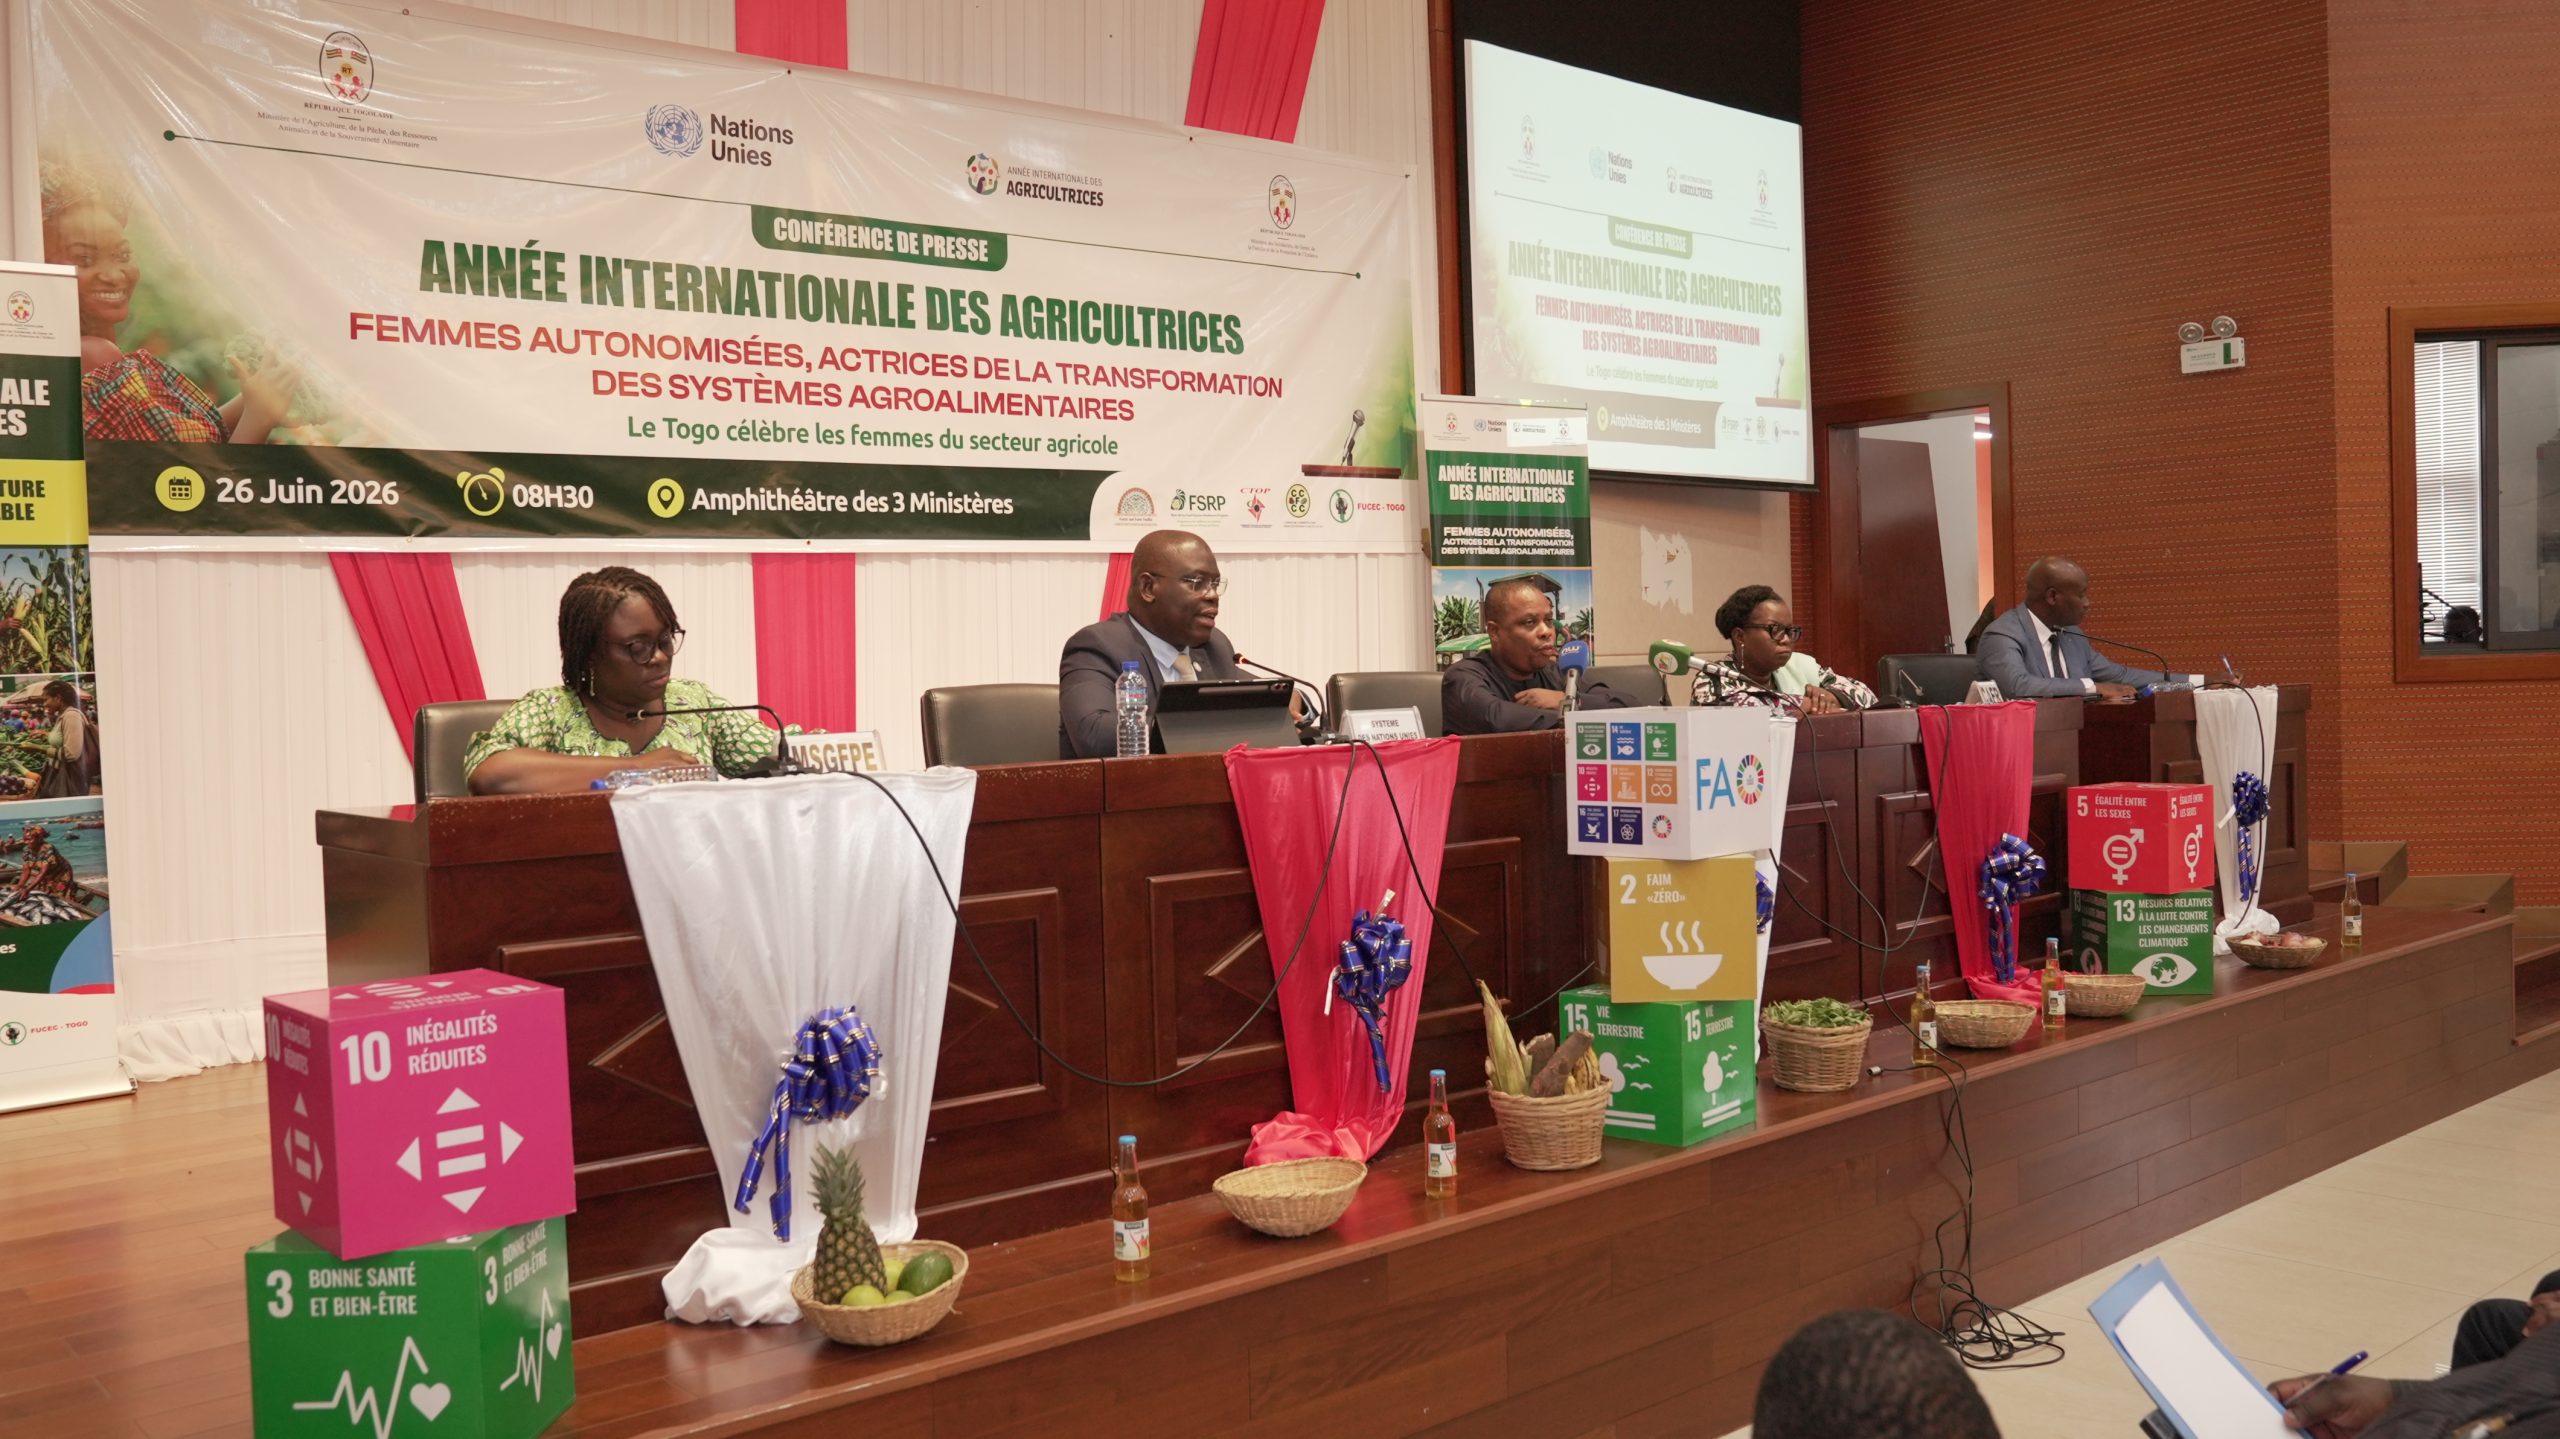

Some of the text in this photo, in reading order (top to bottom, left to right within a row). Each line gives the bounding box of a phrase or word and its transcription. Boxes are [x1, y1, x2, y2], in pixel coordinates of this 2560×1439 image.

[390, 129, 400, 137] des
[402, 131, 438, 142] Ressources
[710, 113, 794, 145] Nations
[711, 139, 773, 167] Unies
[1608, 151, 1632, 170] Nations
[1008, 165, 1103, 187] ANNÉE INTERNATIONALE DES
[1608, 167, 1627, 184] Unies
[1006, 180, 1104, 207] AGRICULTRICES
[773, 216, 989, 262] CONFÉRENCE DE PRESSE
[1508, 239, 1782, 317] ANNÉE INTERNATIONALE DES AGRICULTRICES
[419, 239, 1245, 355] ANNÉE INTERNATIONALE DES AGRICULTRICES
[1535, 294, 1569, 320] FEMMES
[1636, 312, 1673, 335] ACTRICES
[1675, 317, 1683, 335] DE
[1685, 319, 1694, 337] LA
[1695, 319, 1760, 346] TRANSFORMATION
[350, 312, 1283, 398] FEMMES AUTONOMISÉES, ACTRICES DE LA TRANSFORMATION
[1582, 330, 1717, 365] DES SYSTÈMES AGROALIMENTAIRES
[592, 369, 1135, 421] DES SYSTÈMES AGROALIMENTAIRES
[628, 416, 1119, 457] Le Togo célèbre les femmes du secteur agricole
[1654, 418, 1665, 430] des
[1666, 420, 1670, 431] 3
[1438, 463, 1575, 486] ANNÉE INTERNATIONALE
[216, 477, 399, 505] 26 Juin 2026
[512, 484, 594, 509] 08H30
[691, 487, 1014, 516] Amphithéâtre des 3 Ministères
[1189, 495, 1226, 511] FSRP
[1450, 484, 1566, 503] DES AGRICULTRICES
[1357, 503, 1380, 511] FUCEC
[1443, 526, 1574, 540] FEMMES AUTONOMISÉES,
[1443, 538, 1482, 546] ACTRICES
[1506, 539, 1574, 547] TRANSFORMATION
[1441, 547, 1459, 555] DES
[1501, 547, 1575, 556] AGROALIMENTAIRES
[2077, 793, 2147, 817] 5 ÉGALITÉ ENTRE
[2095, 809, 2131, 819] LES SEXES
[2171, 797, 2178, 819] 5
[1620, 873, 1672, 904] 2 FAIM
[2113, 898, 2213, 922] 13 MESURES RELATIVES
[2138, 910, 2208, 921] À LA LUTTE CONTRE
[2139, 924, 2209, 935] LES CHANGEMENTS
[2139, 938, 2188, 948] CLIMATIQUES
[31, 1020, 88, 1033] FUCEC TOGO
[1564, 1003, 1610, 1032] 15 VIE
[1685, 1005, 1714, 1042] 15 VIE
[1705, 1016, 1734, 1036] TERRESTRE
[266, 1013, 281, 1062] 10
[1597, 1022, 1644, 1039] TERRESTRE
[340, 1010, 498, 1085] 10 INÉGALITÉS
[408, 1044, 487, 1075] RÉDUITES
[484, 1219, 547, 1305] 3 BONNE SANTÉ
[504, 1247, 548, 1295] ET BIEN-ÊTRE
[266, 1261, 416, 1318] 3 BONNE SANTÉ
[310, 1291, 417, 1317] ET BIEN-ÊTRE
